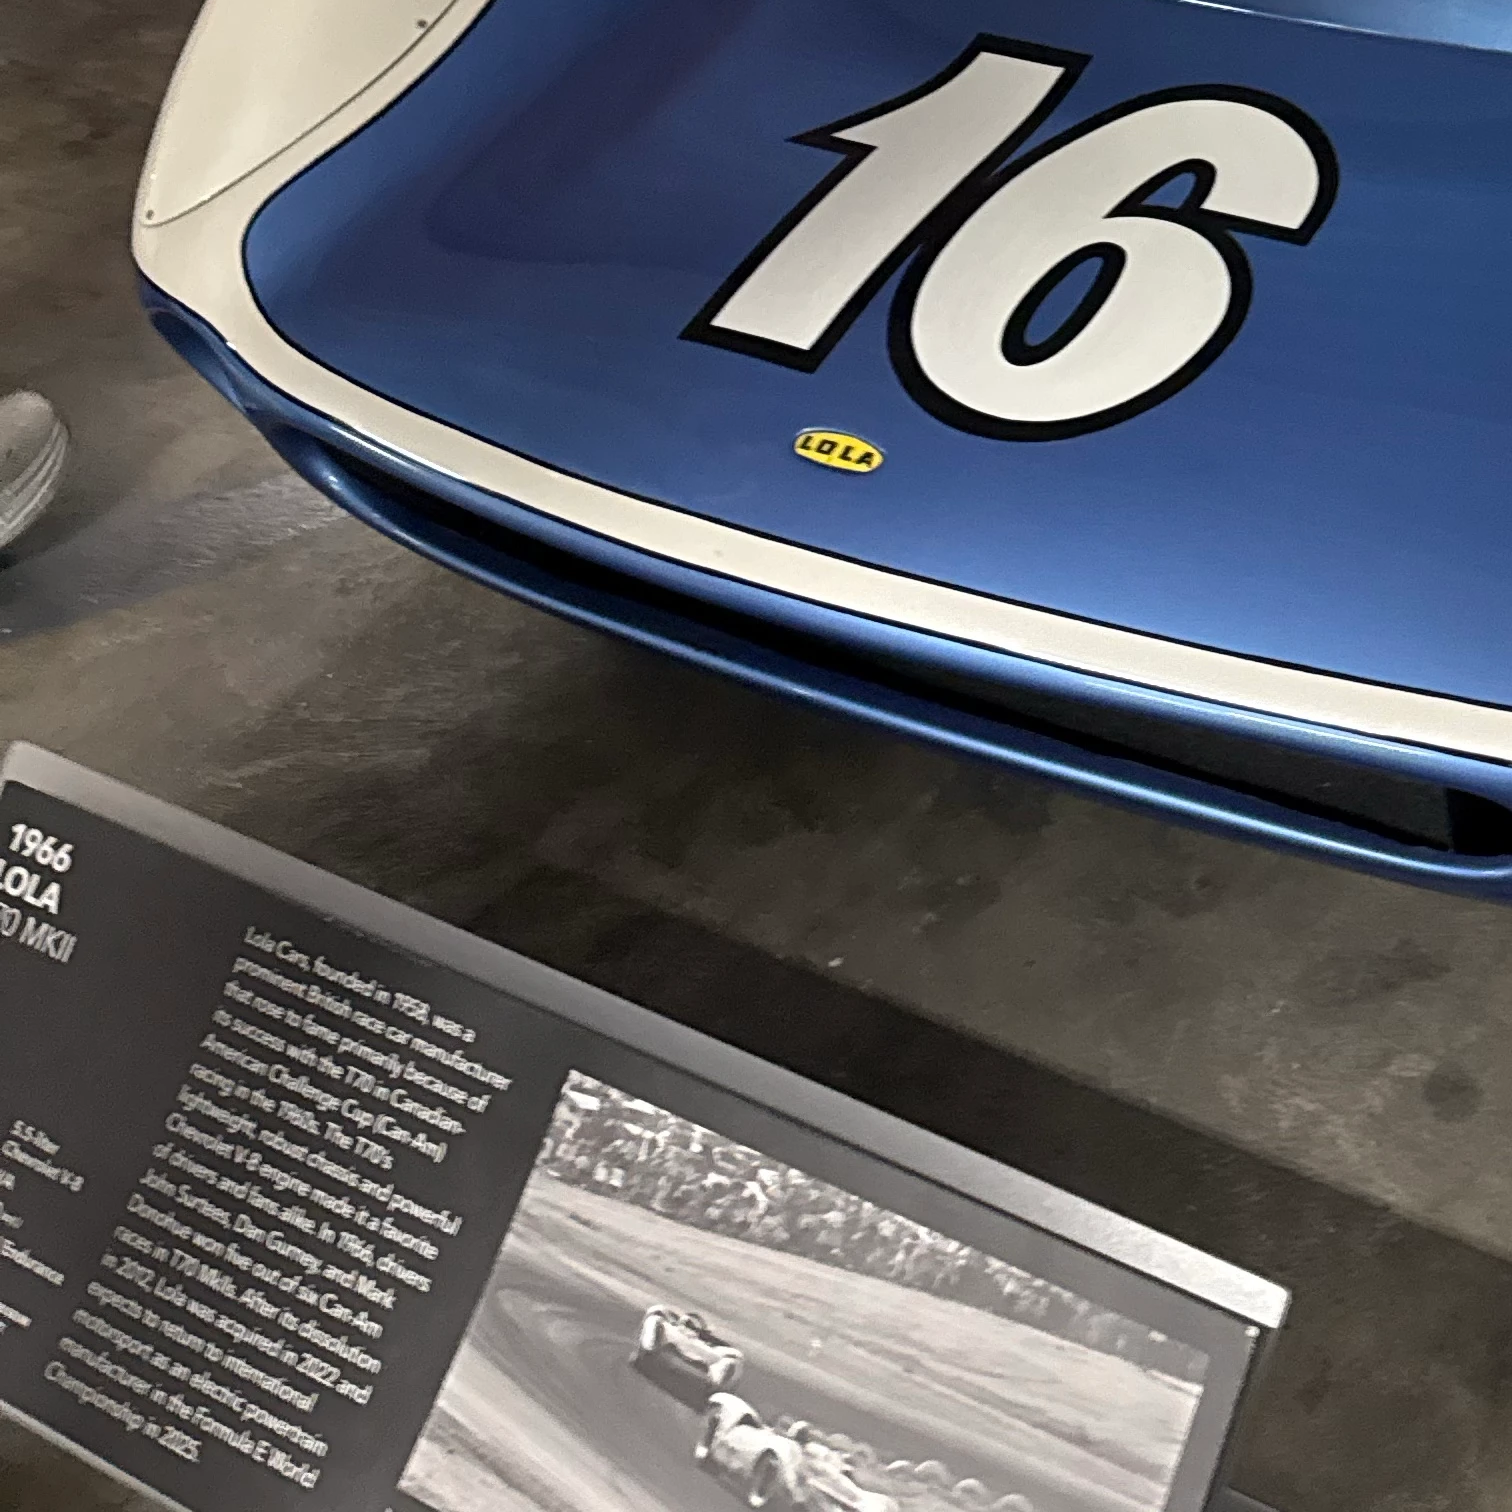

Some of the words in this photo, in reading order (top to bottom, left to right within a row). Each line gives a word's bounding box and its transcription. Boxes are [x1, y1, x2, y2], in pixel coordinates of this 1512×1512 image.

[678, 32, 1340, 442] 16
[798, 435, 875, 467] LOLA
[8, 823, 75, 873] 1966
